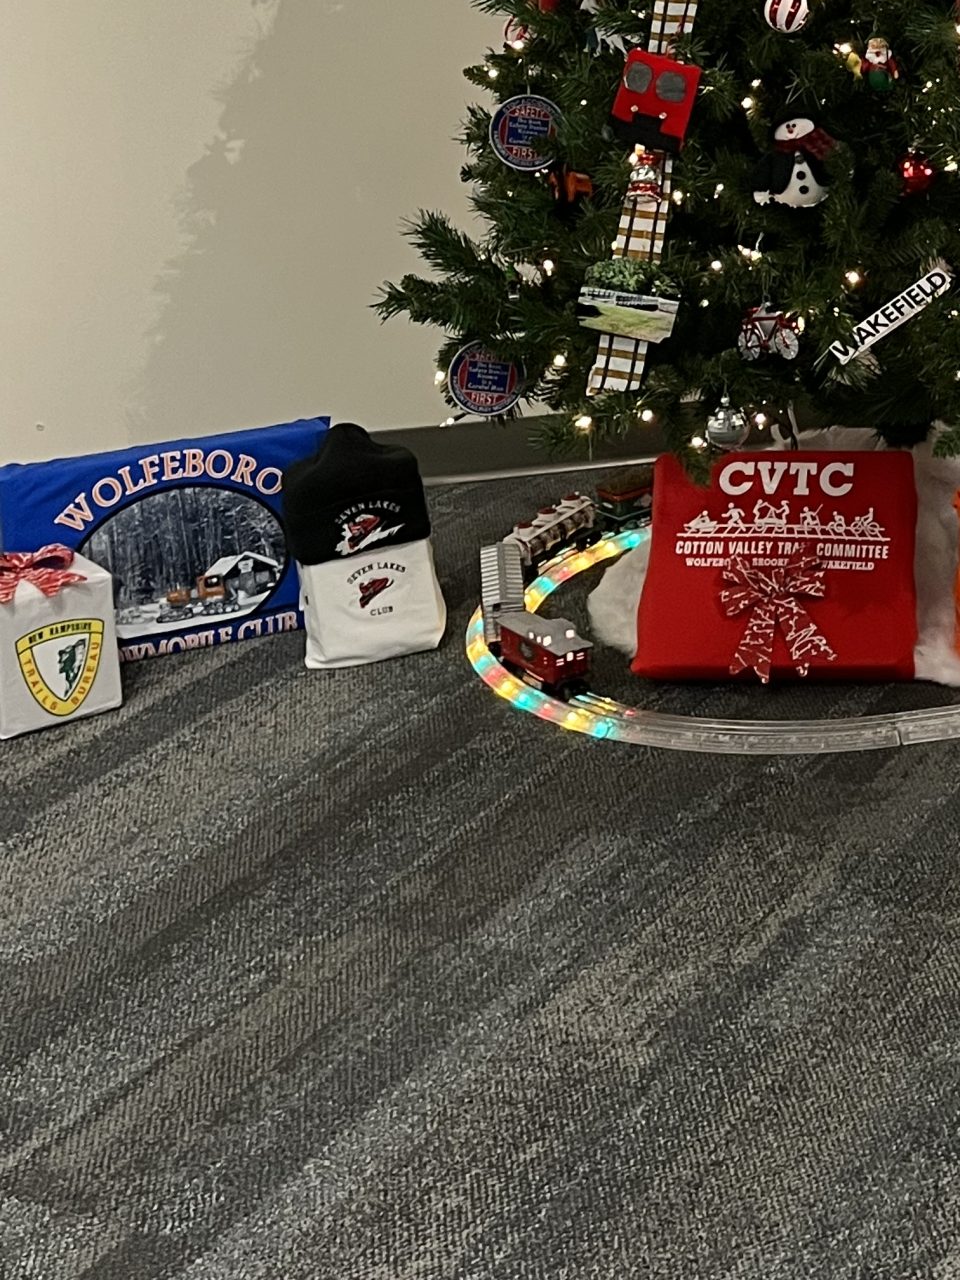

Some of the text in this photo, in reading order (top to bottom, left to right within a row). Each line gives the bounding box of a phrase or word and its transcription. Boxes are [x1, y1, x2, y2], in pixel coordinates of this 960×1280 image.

[514, 106, 545, 118] SAFETY
[831, 272, 947, 357] WAKEFIELD
[471, 393, 498, 405] FIRST
[53, 448, 284, 531] WOLFEBORO
[718, 461, 855, 497] CVTC
[334, 500, 400, 524] SEVEN LAKES
[675, 540, 724, 555] COTTON
[728, 541, 774, 555] VALLEY
[816, 543, 889, 560] COMMITTEE
[347, 562, 406, 584] SEVEN LAKES
[370, 606, 394, 616] CLUB
[28, 622, 92, 644] NEW HAMPSHIRE
[23, 641, 100, 711] TRAILS BUREAU
